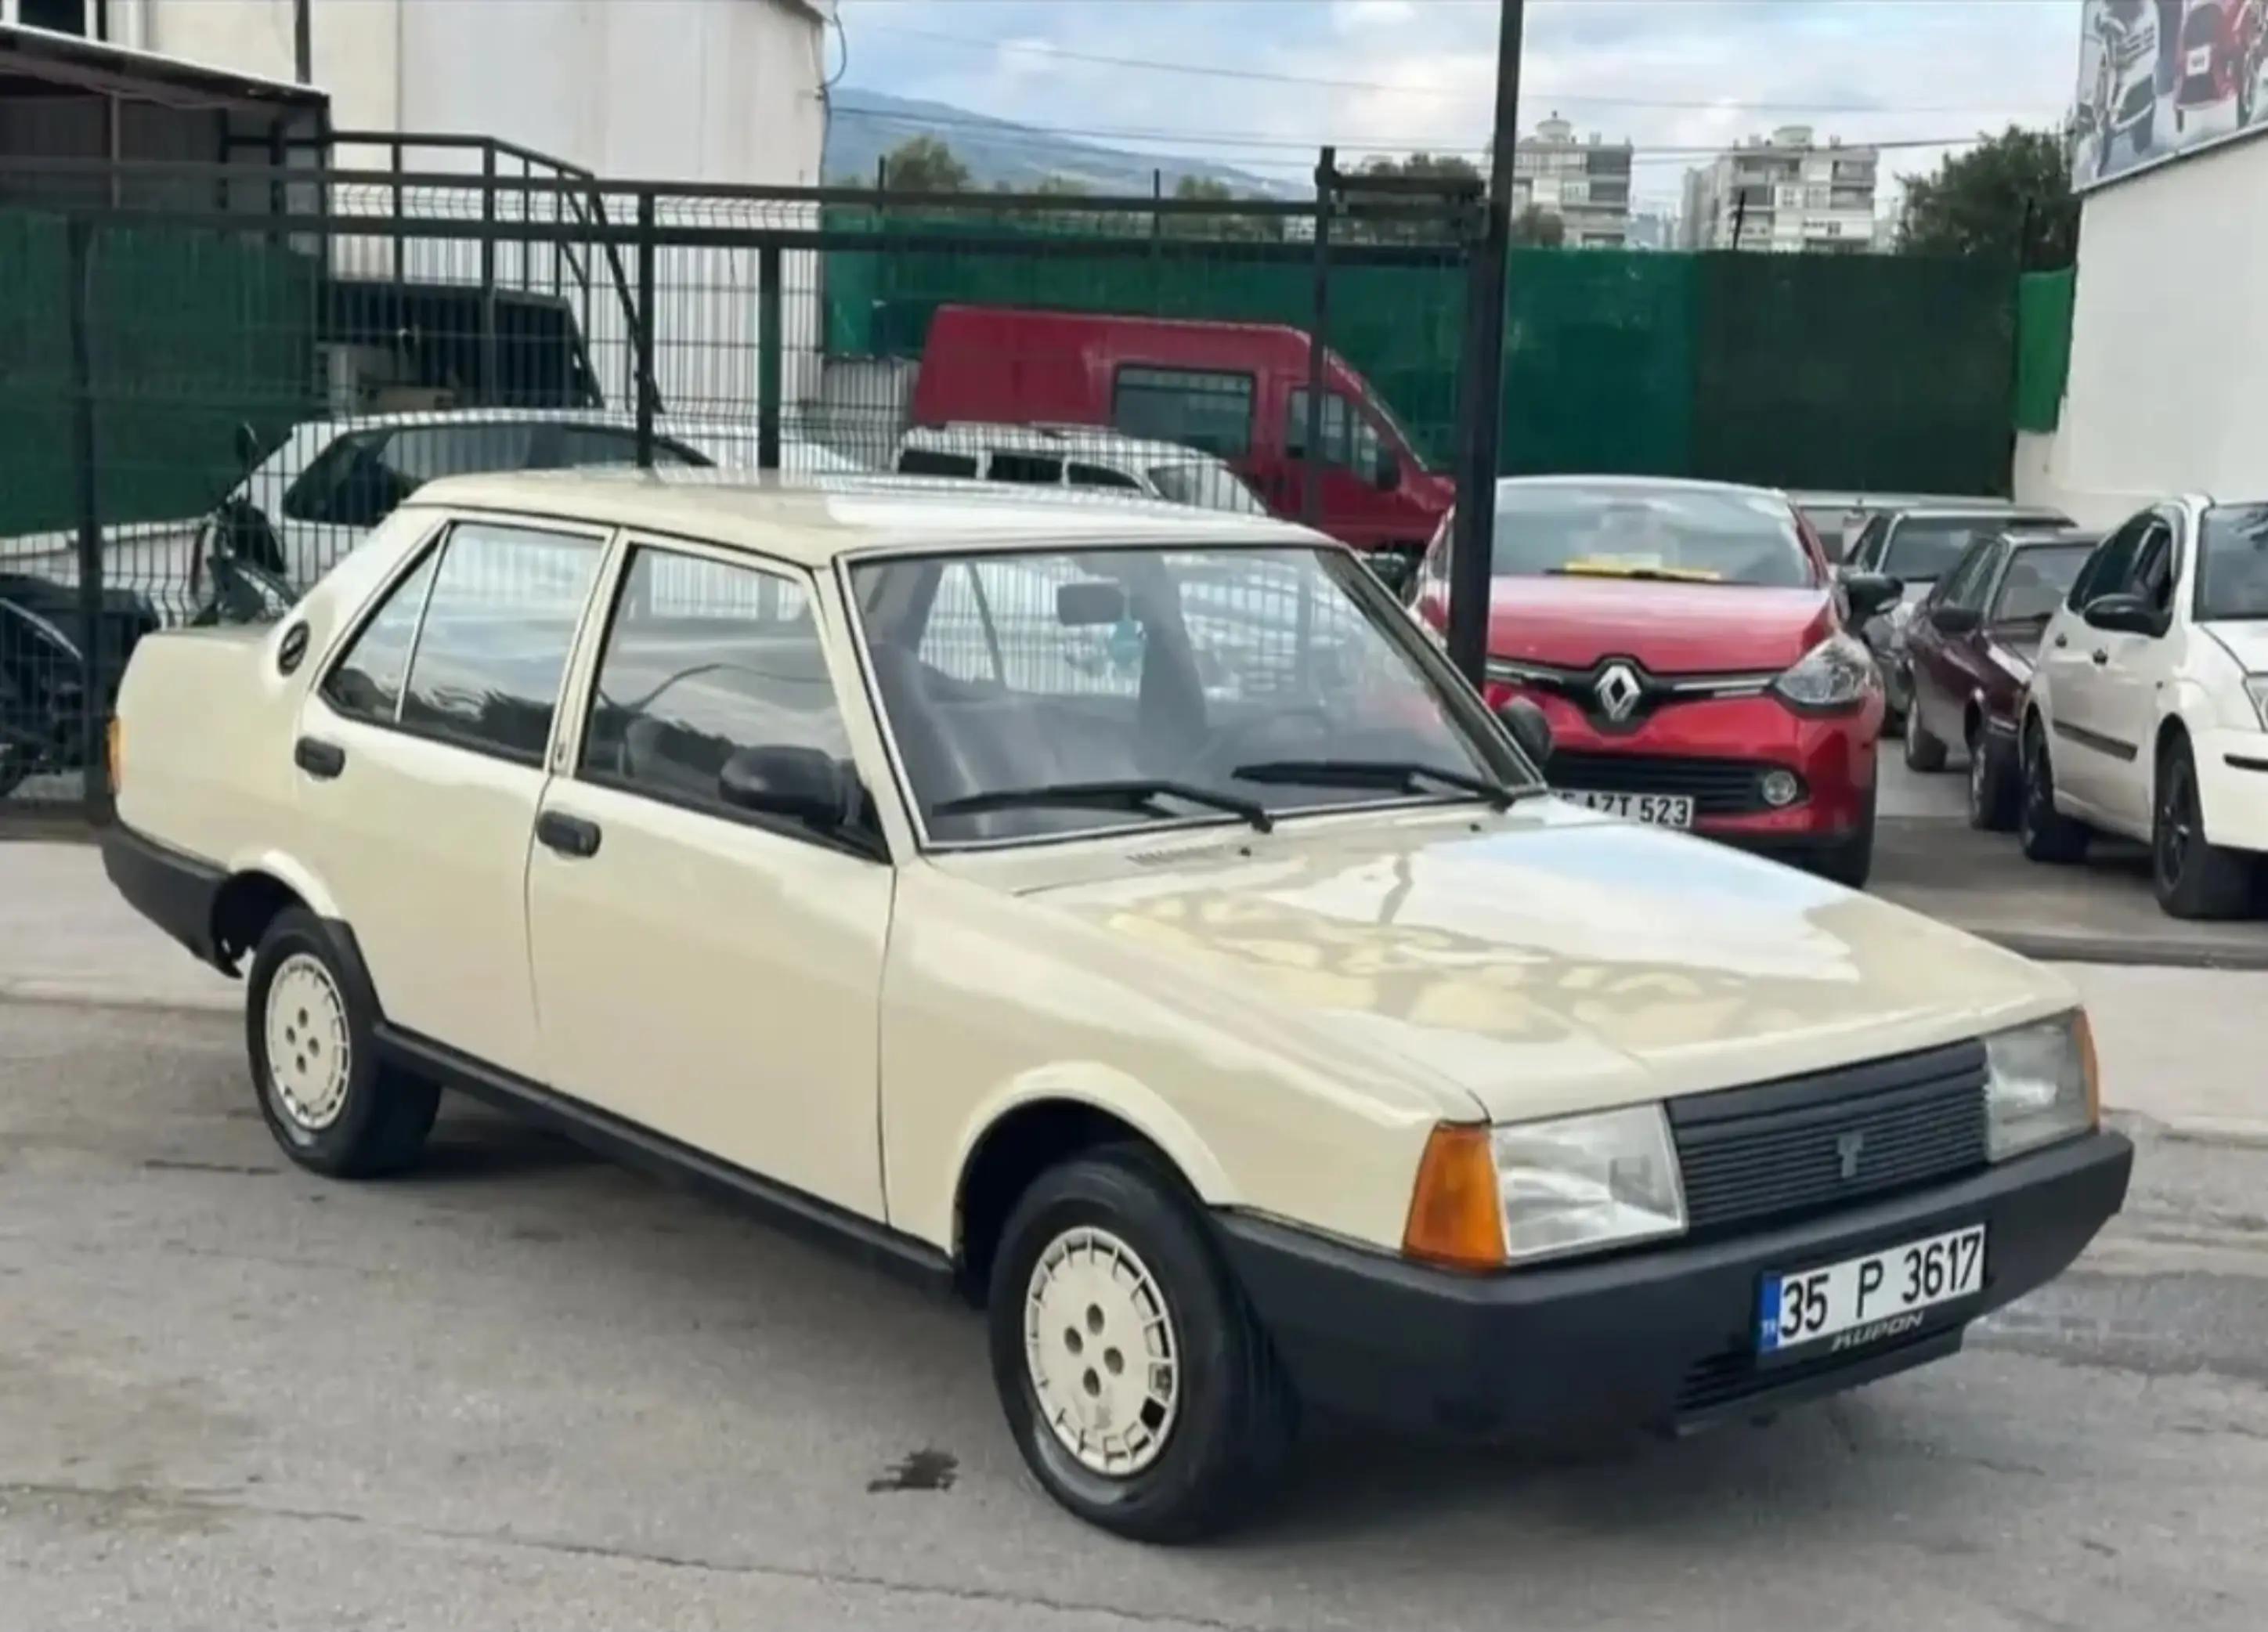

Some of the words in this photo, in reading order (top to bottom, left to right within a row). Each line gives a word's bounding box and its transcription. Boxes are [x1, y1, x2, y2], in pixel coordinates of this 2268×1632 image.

[1640, 797, 1688, 824] 523
[1782, 1274, 1829, 1338] 35
[1856, 1259, 1883, 1319] P
[1902, 1233, 1981, 1304] 3617
